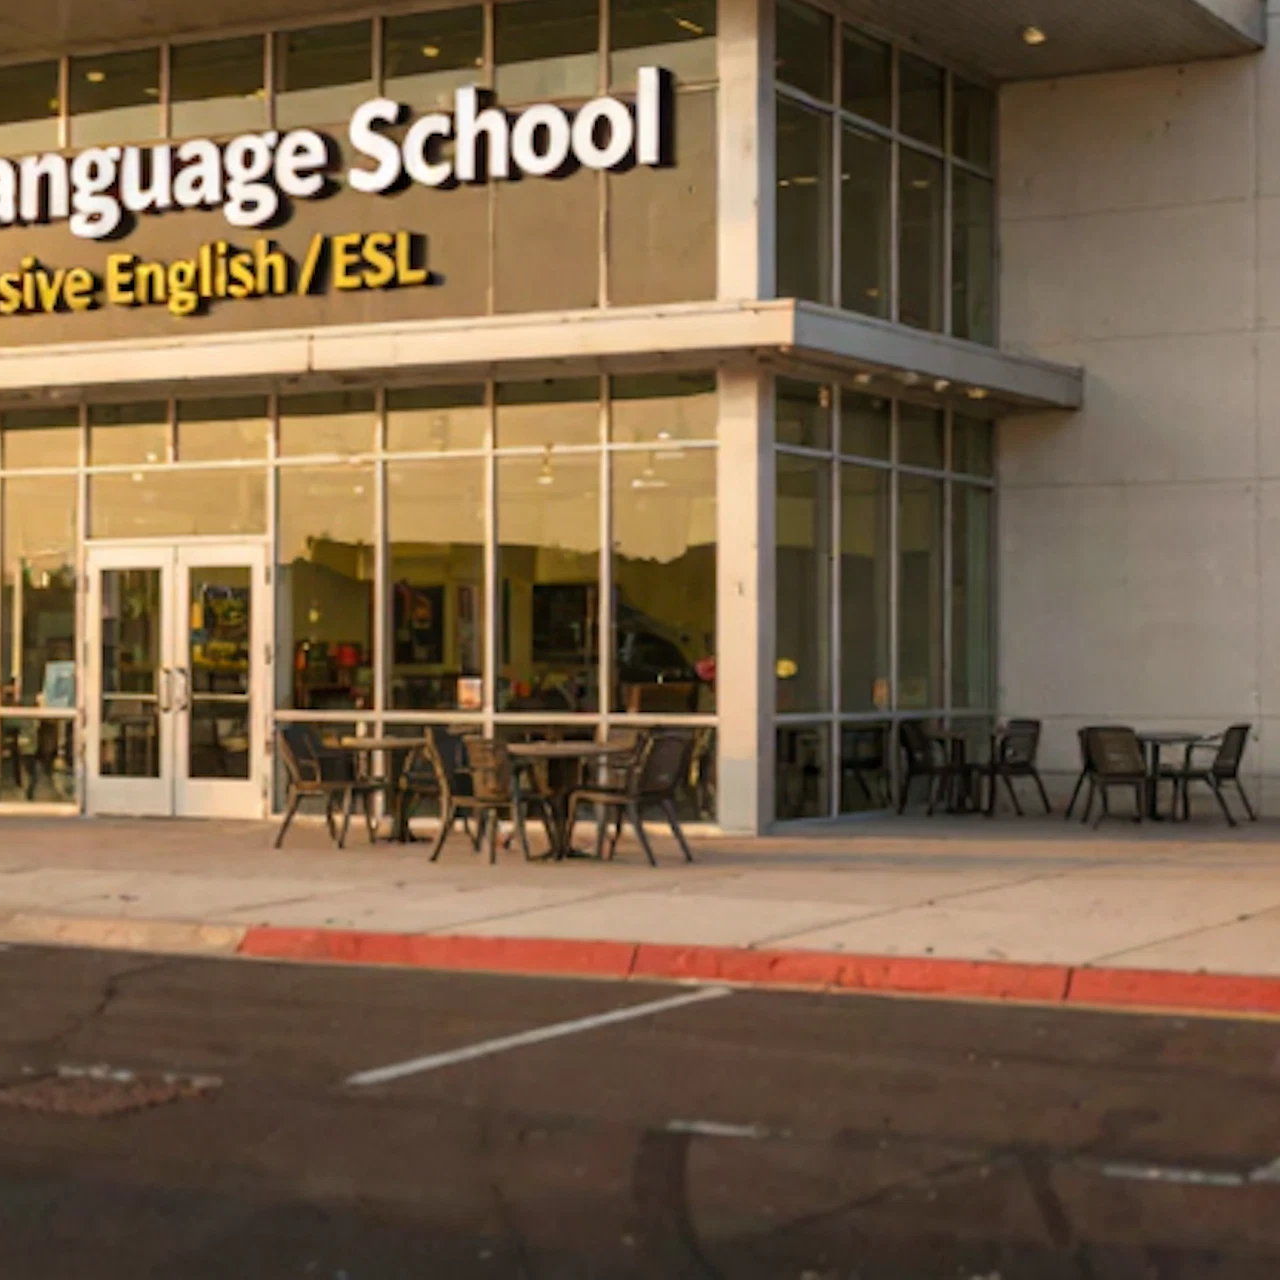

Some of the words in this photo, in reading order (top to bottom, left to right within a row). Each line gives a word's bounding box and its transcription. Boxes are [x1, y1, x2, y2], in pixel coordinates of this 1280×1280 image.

[348, 66, 662, 194] School
[106, 238, 288, 317] English
[332, 230, 429, 290] ESL
